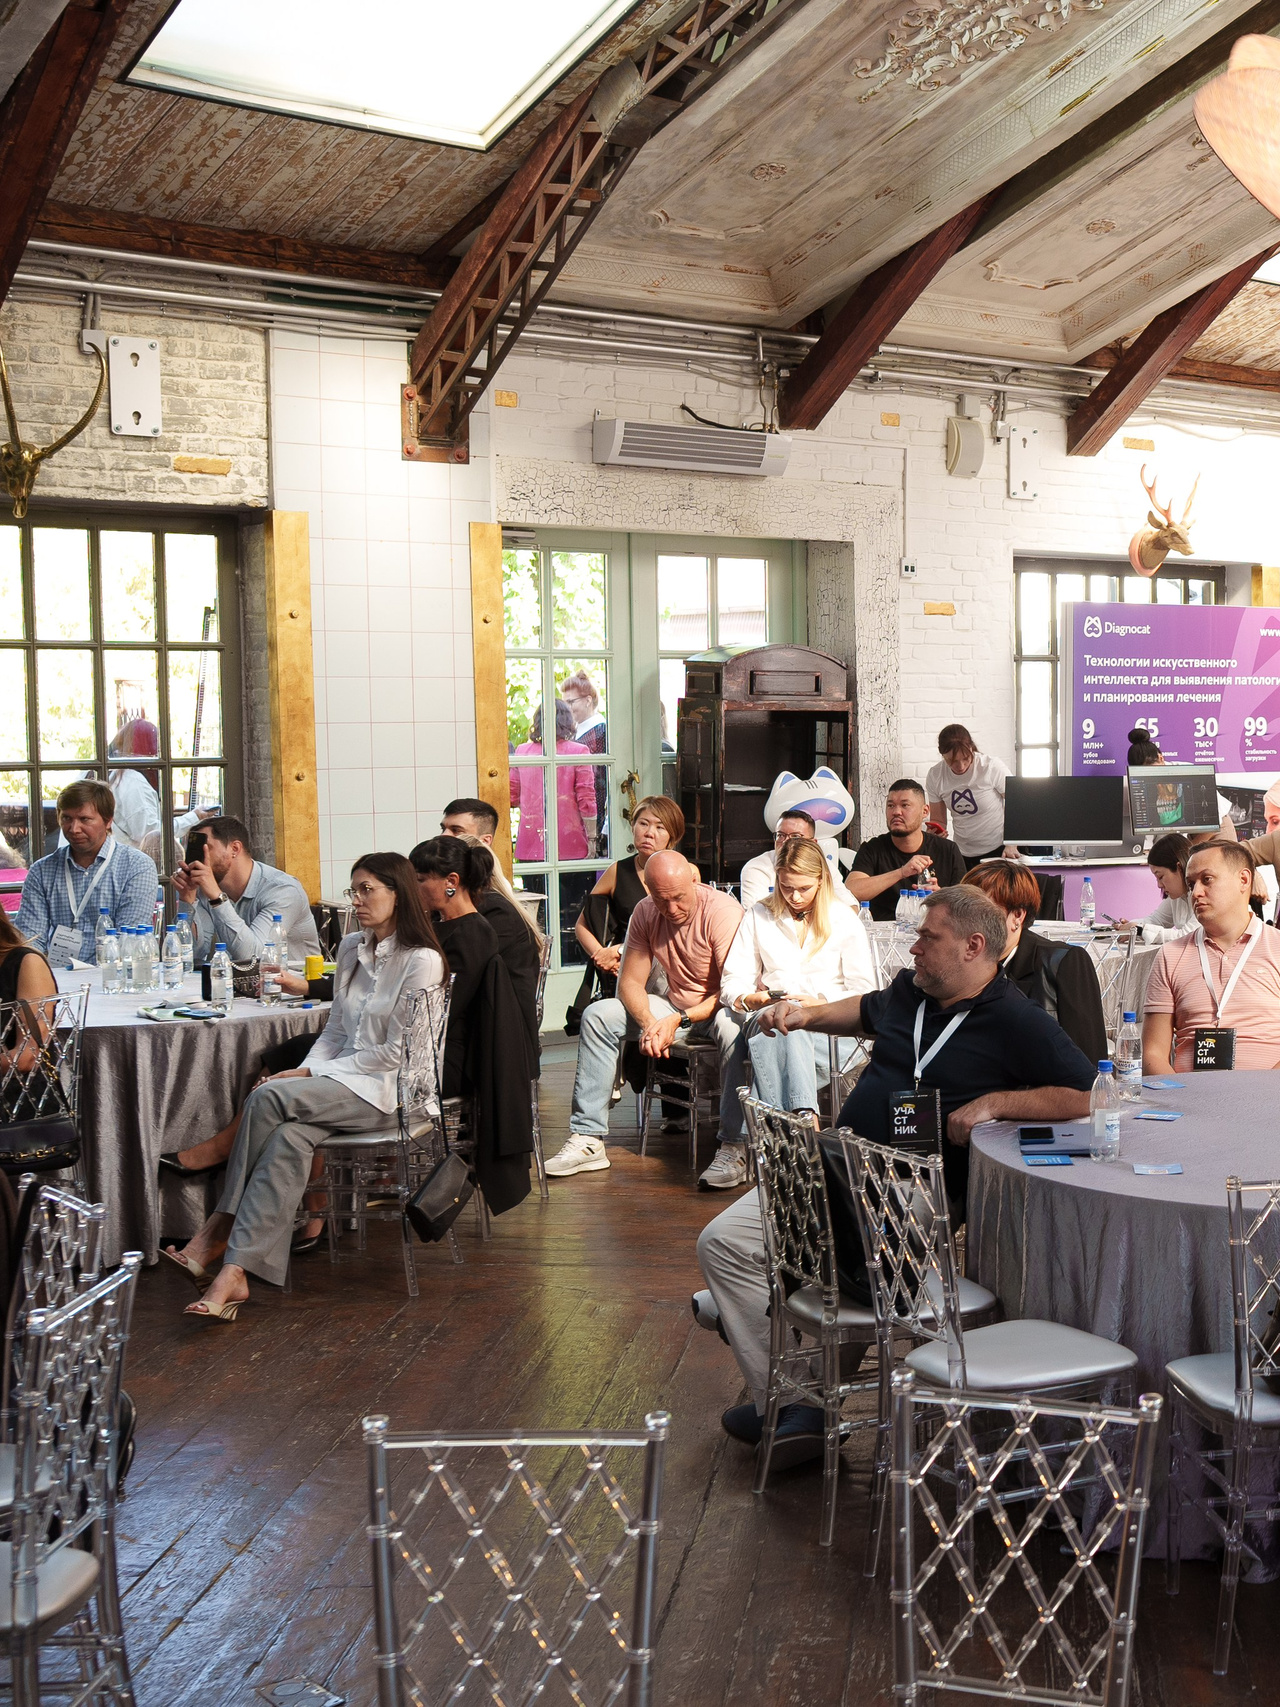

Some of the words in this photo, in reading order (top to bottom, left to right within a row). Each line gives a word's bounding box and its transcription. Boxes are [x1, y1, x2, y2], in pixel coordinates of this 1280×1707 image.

[1104, 622, 1151, 636] Diagnocat
[1083, 655, 1150, 667] Технологии
[1152, 658, 1238, 670] искусственного
[1083, 675, 1149, 685] интеллекта
[1150, 676, 1171, 686] для
[1173, 676, 1232, 686] выявления
[1083, 693, 1090, 702] и
[1093, 693, 1174, 705] планирования
[1176, 694, 1222, 702] лечения
[1082, 718, 1095, 740] 9
[1193, 717, 1219, 738] 30
[1244, 716, 1268, 736] 99
[1245, 738, 1253, 746] %
[1198, 1040, 1216, 1048] УЧА
[894, 1106, 915, 1115] УЧА
[894, 1116, 908, 1125] СТ
[894, 1126, 918, 1135] НИК
